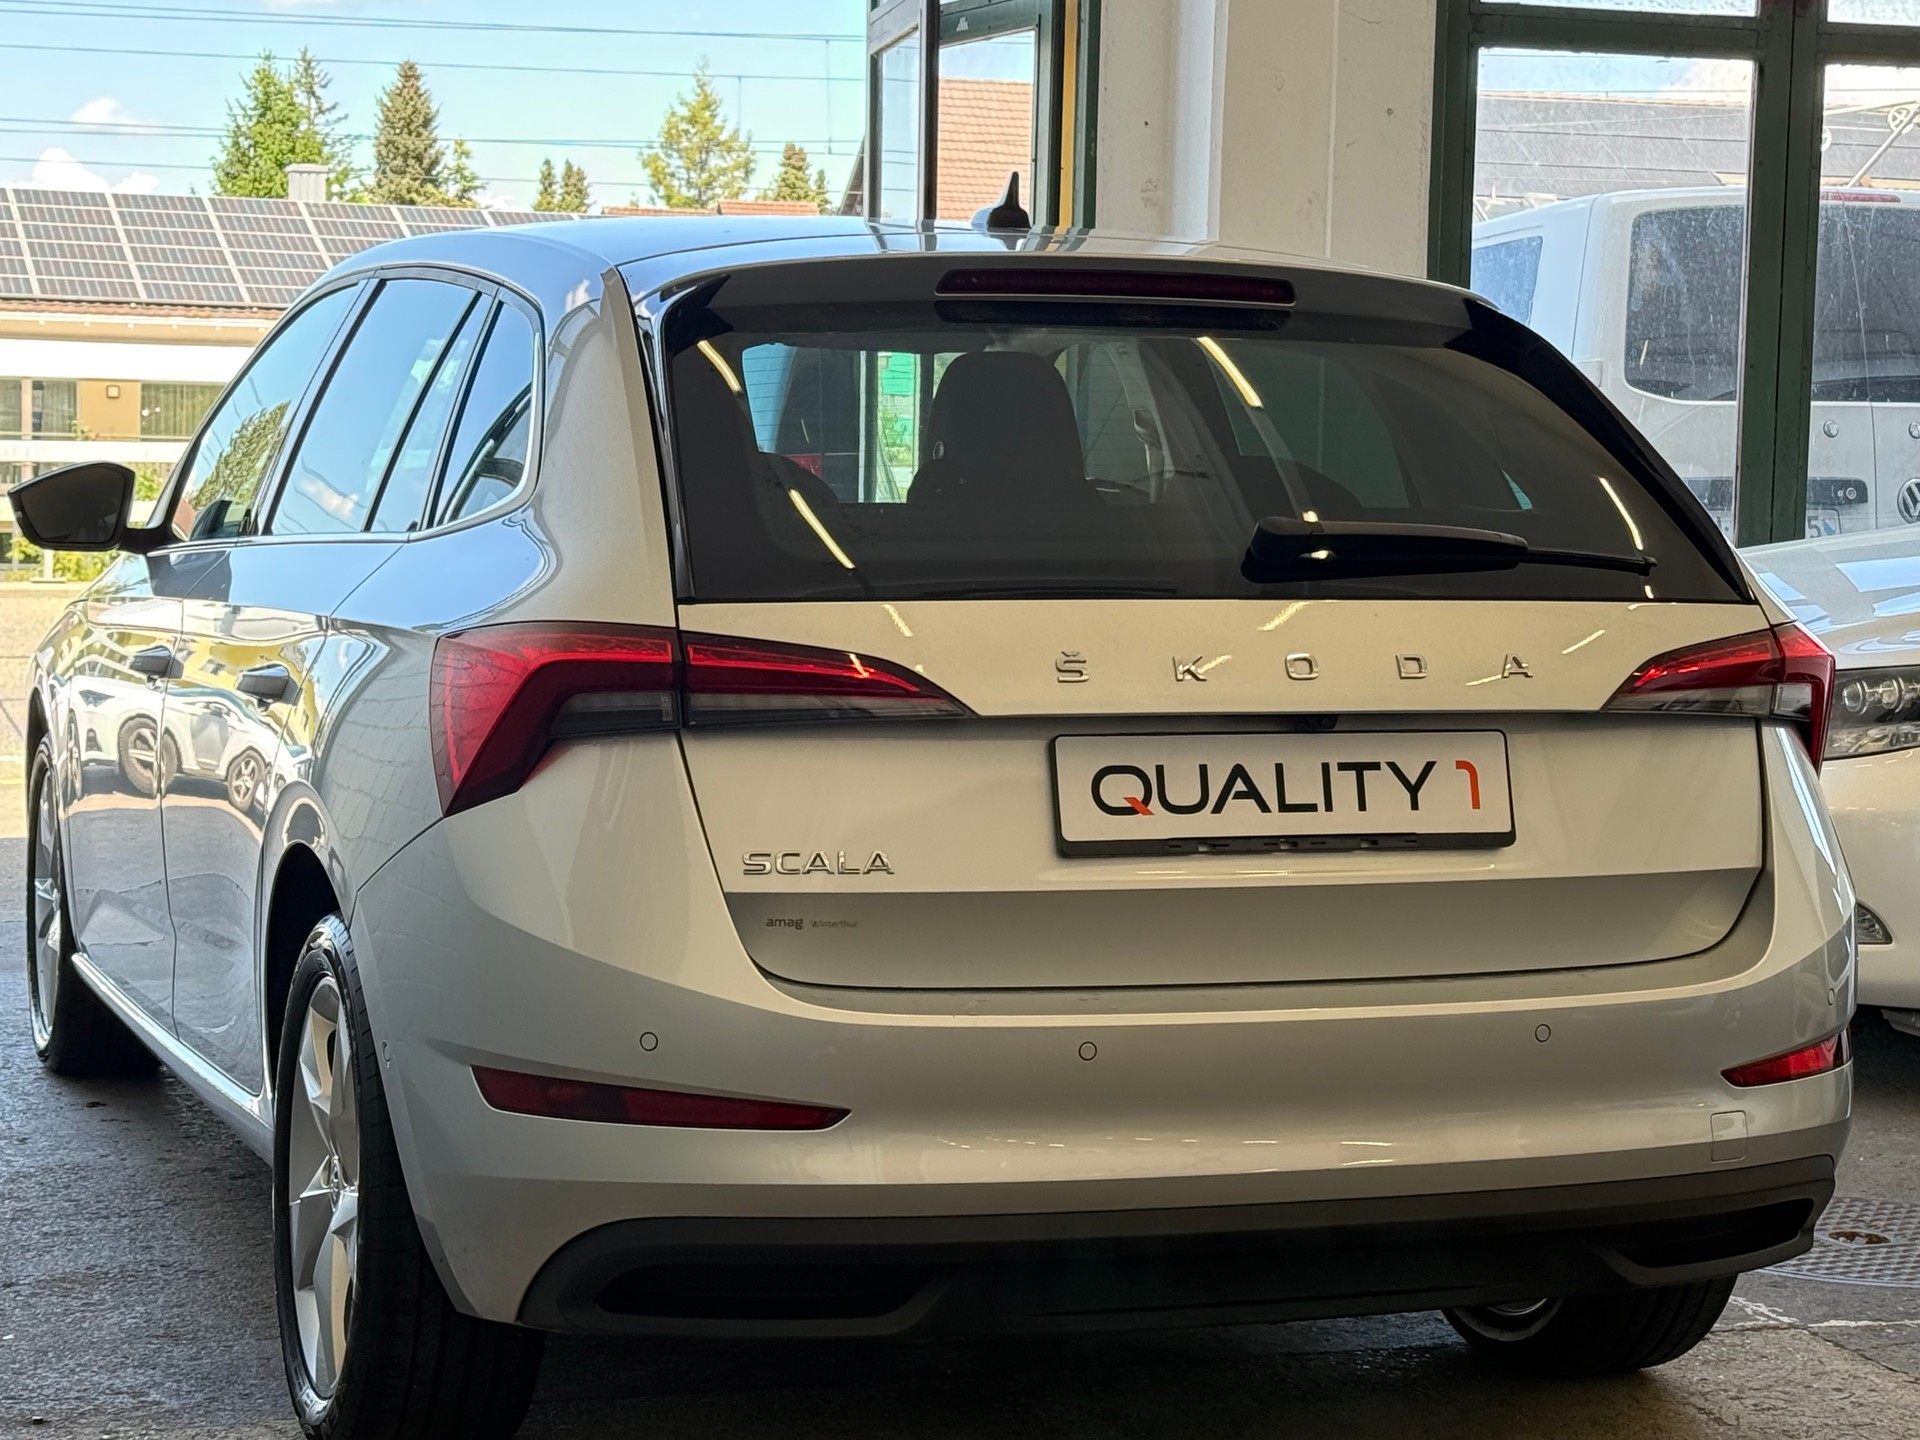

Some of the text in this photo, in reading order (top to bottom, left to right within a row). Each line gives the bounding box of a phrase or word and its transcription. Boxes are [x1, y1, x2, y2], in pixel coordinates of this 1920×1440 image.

[1055, 650, 1535, 684] ŠKODA
[1091, 760, 1481, 816] QUALITY 1
[743, 850, 895, 875] SCALA
[766, 918, 804, 930] amag
